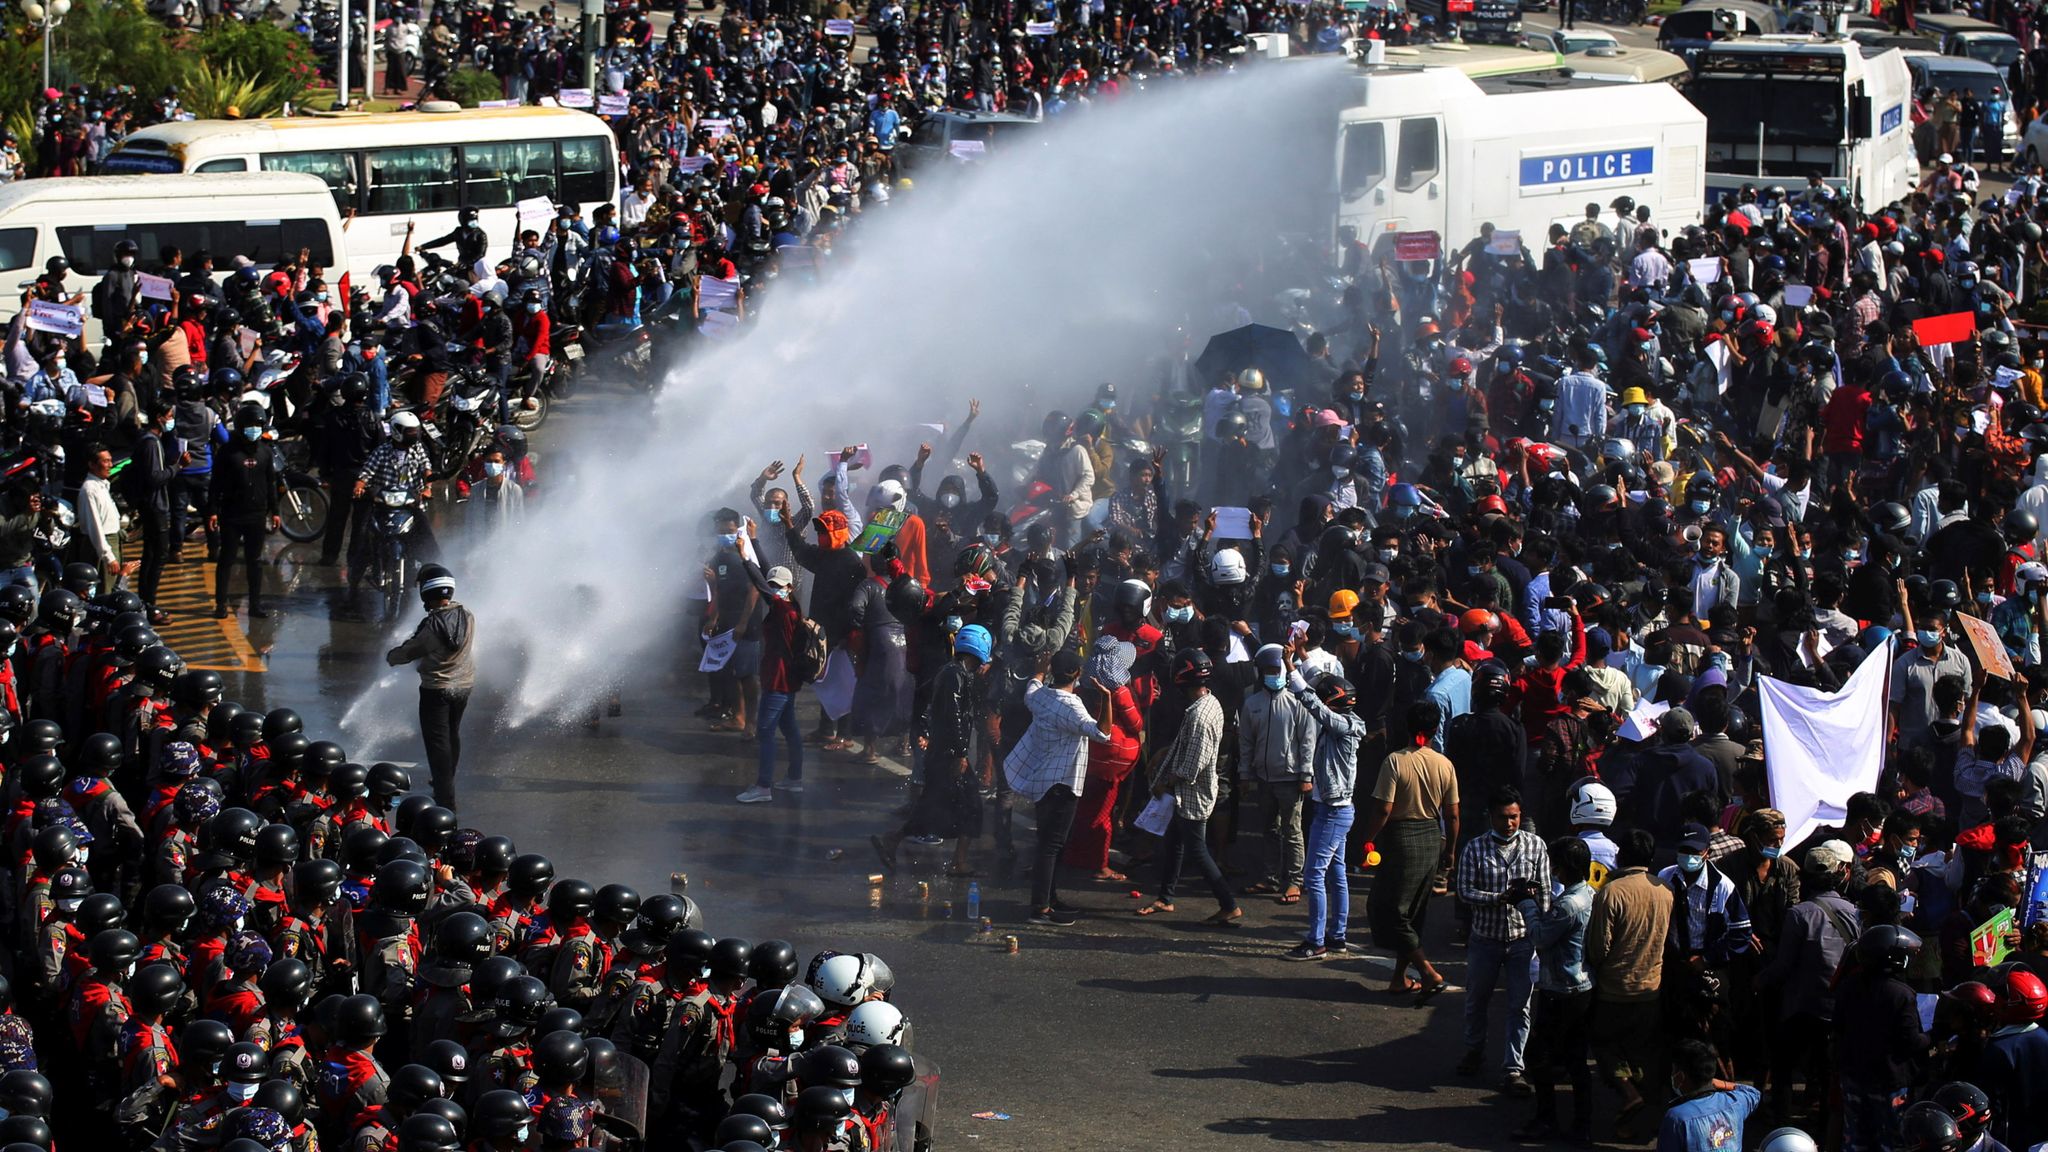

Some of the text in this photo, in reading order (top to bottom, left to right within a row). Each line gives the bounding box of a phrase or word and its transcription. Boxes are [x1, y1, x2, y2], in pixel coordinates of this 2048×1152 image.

[1477, 11, 1507, 19] POLICE
[1543, 153, 1631, 182] POLICE
[54, 611, 70, 620] POLICE
[159, 669, 174, 679] POLICE
[240, 835, 256, 846] POLICE
[476, 944, 491, 952] POLICE
[755, 1026, 778, 1036] POLICE
